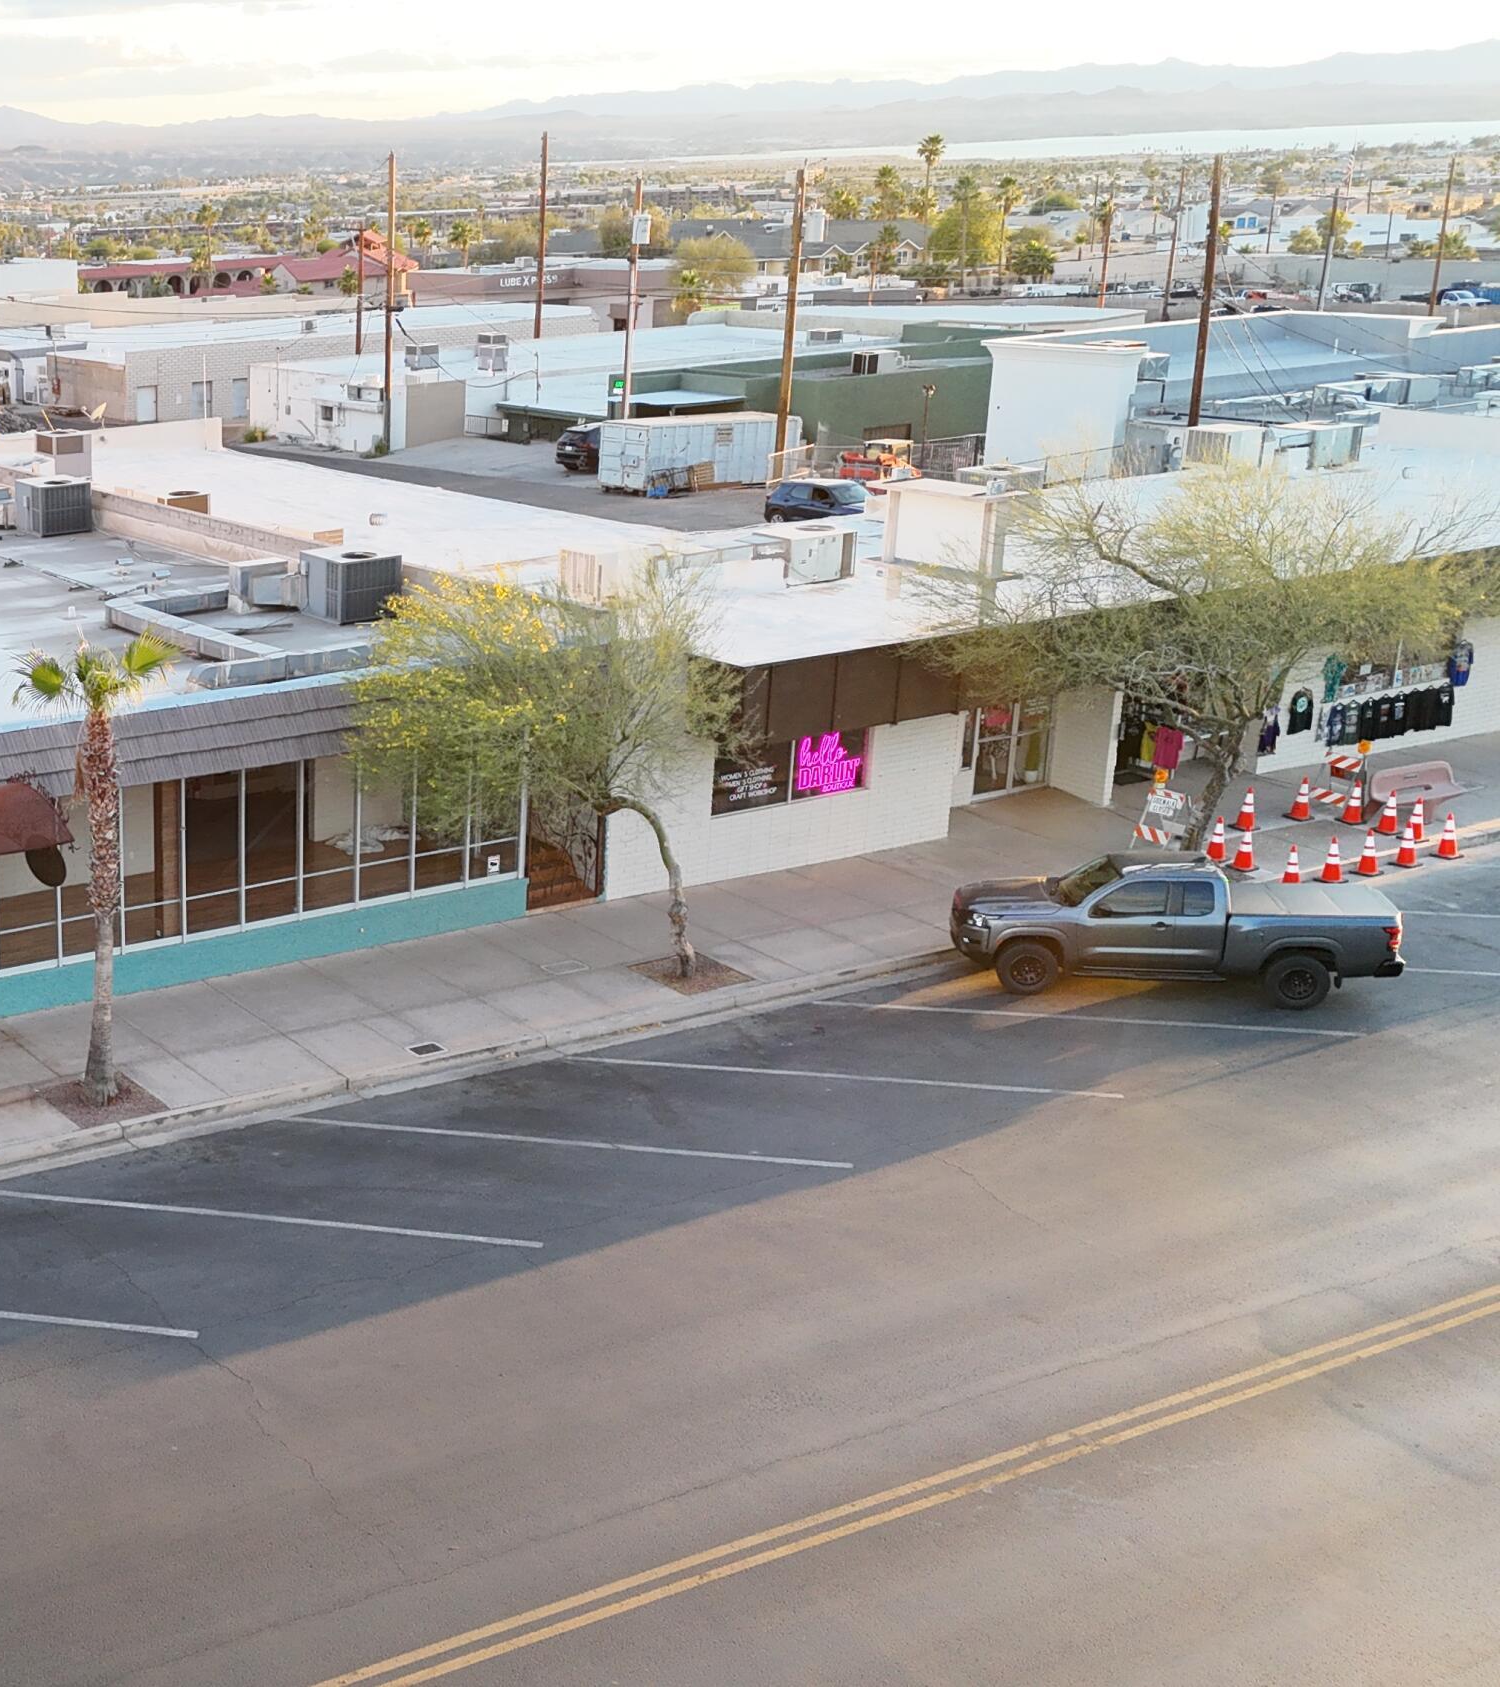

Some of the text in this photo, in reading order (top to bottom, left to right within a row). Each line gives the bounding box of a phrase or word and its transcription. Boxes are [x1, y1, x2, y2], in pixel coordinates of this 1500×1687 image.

[500, 275, 558, 287] LUBE XPESS
[800, 731, 847, 766] hello
